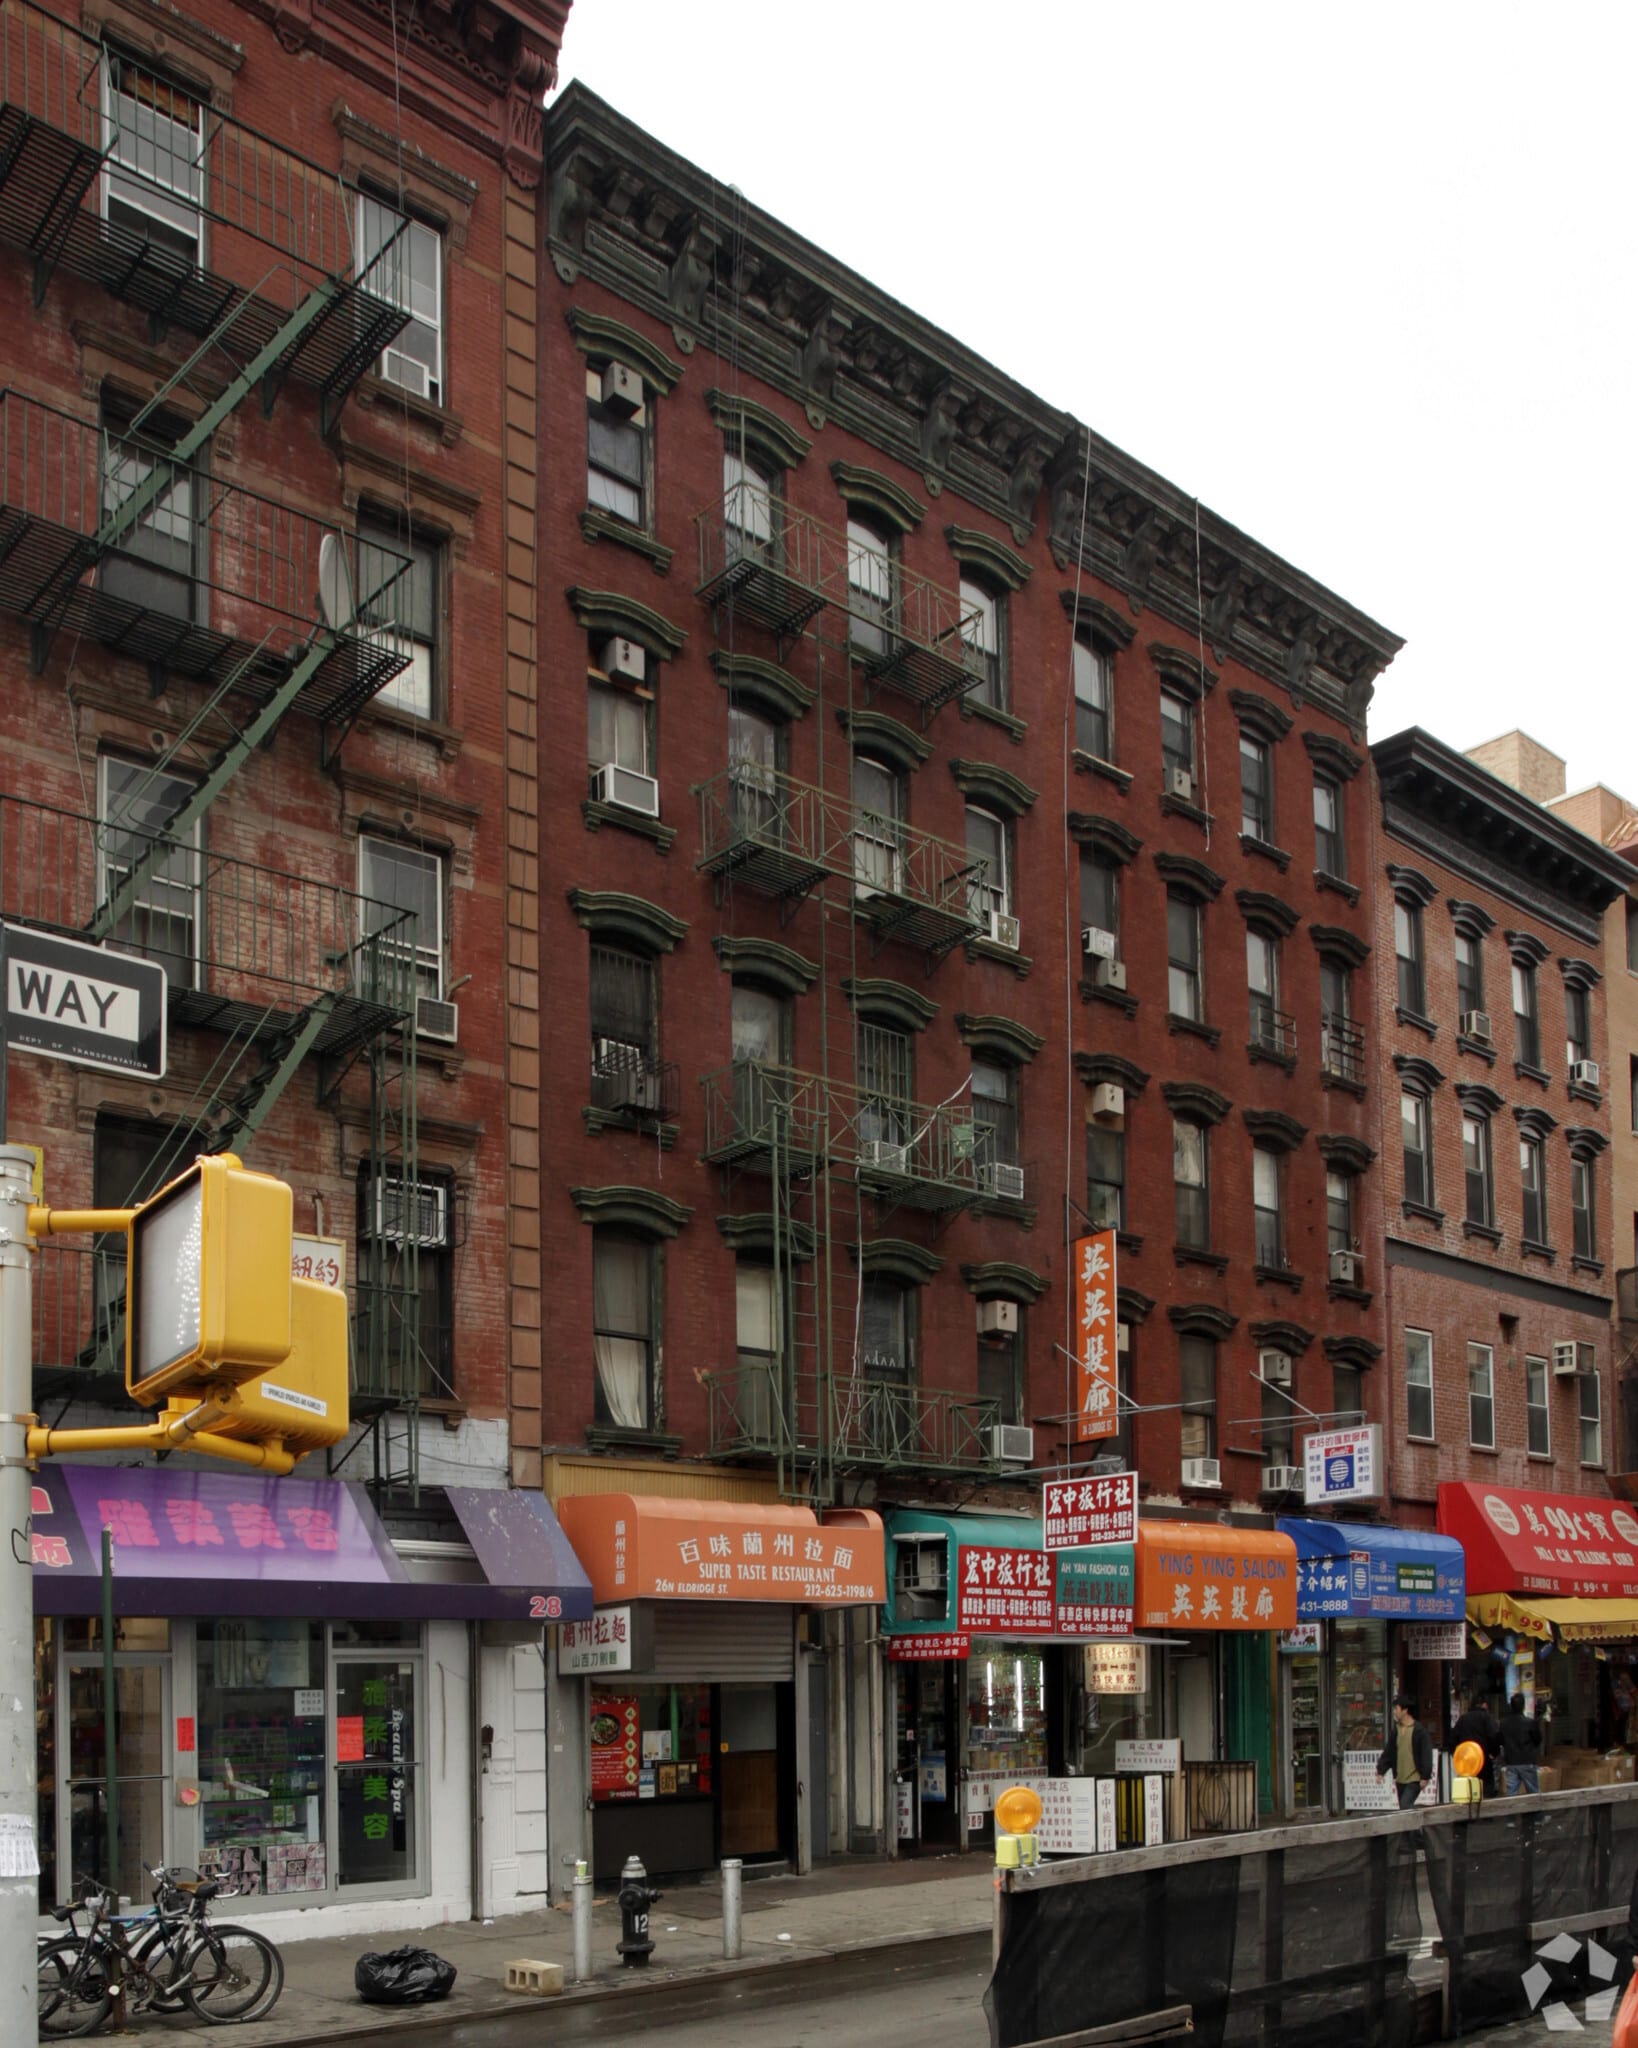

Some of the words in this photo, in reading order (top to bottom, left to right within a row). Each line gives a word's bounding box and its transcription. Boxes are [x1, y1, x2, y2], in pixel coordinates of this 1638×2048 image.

[16, 966, 120, 1029] WAY
[19, 1034, 42, 1045] DEPT
[51, 1041, 63, 1049] OF
[72, 1046, 148, 1069] TRANSPORTATION
[1081, 1243, 1111, 1417] 英英髮廊
[1047, 1479, 1132, 1515] 宏中旅行社
[677, 1531, 854, 1571] 百味蘭州拉面
[964, 1550, 1052, 1587] 宏中旅行社
[1061, 1562, 1071, 1574] AH
[1073, 1562, 1087, 1575] YAN
[1089, 1563, 1117, 1575] FASHION
[1158, 1552, 1193, 1576] YING
[1201, 1555, 1236, 1578] YING
[1242, 1557, 1287, 1579] SALON
[677, 1582, 715, 1594] ELDRIDGE
[717, 1584, 728, 1594] ST.
[699, 1562, 732, 1580] SUPER
[737, 1563, 767, 1581] TASTE
[772, 1565, 835, 1583] RESTAURANT
[530, 1595, 562, 1617] 28
[804, 1583, 874, 1598] 212-625-1198/6
[1003, 1588, 1025, 1597] TRAVEL
[1026, 1589, 1048, 1597] AGENCY
[1171, 1583, 1274, 1621] 英英髮廊
[1519, 1616, 1544, 1631] 99
[363, 1680, 389, 1839] 雅柔美容
[391, 1777, 405, 1813] Spa
